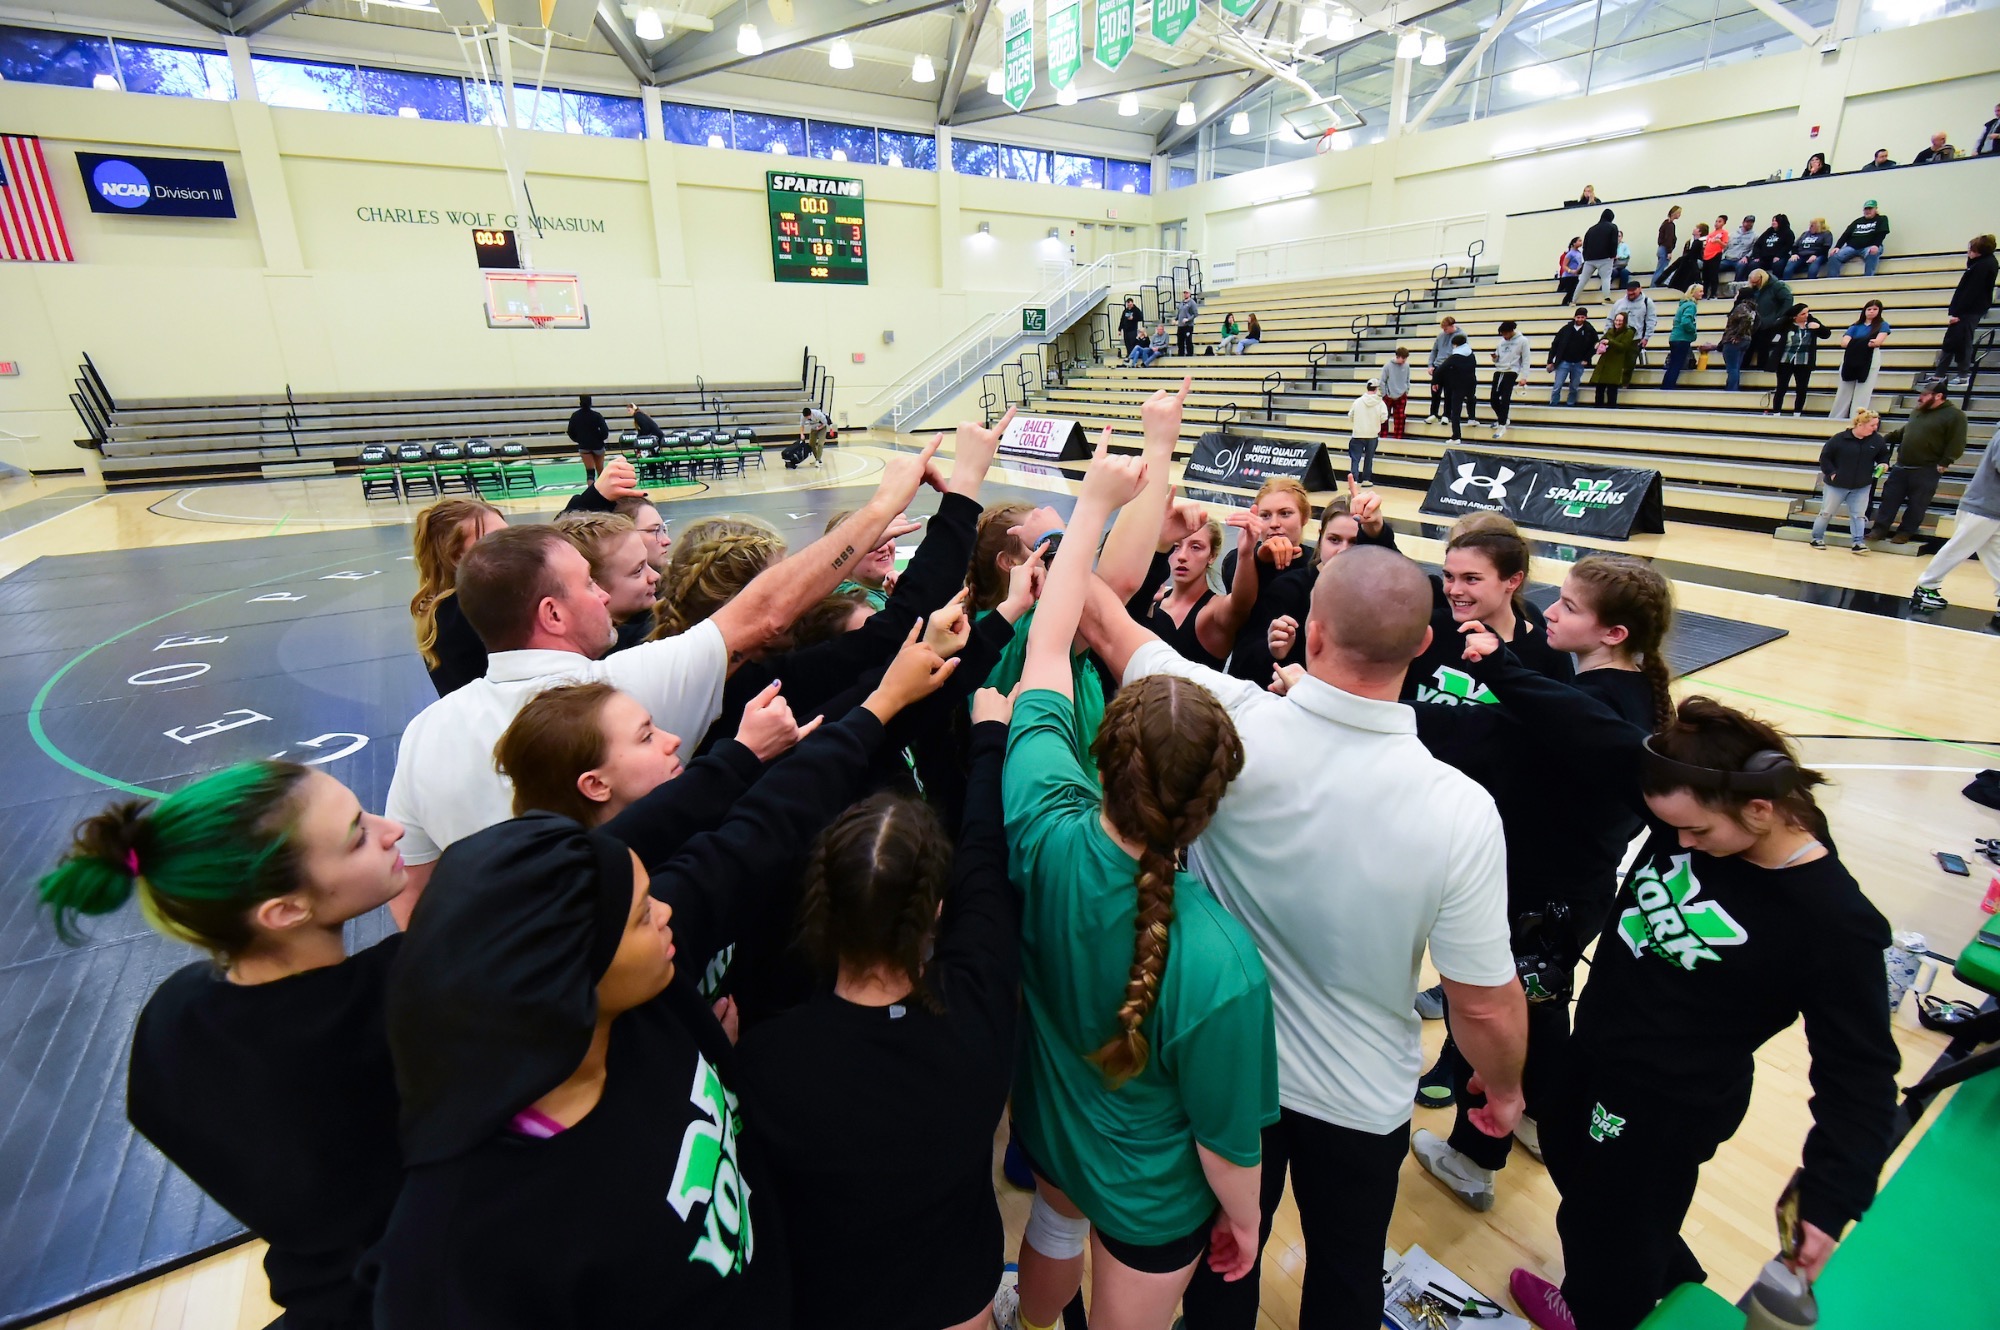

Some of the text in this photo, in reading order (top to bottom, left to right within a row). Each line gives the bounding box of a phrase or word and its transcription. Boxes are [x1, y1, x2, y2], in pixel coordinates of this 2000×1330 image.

[1100, 5, 1131, 47] 2019
[102, 183, 224, 200] NCAA Division III
[773, 175, 860, 196] SPARTANS
[800, 197, 828, 214] 00.0
[357, 207, 605, 233] CHARLES WOLF GMNASIUM
[781, 221, 799, 236] 44
[819, 225, 824, 236] 1
[852, 226, 860, 240] 3
[475, 232, 506, 245] 00.0
[782, 242, 790, 253] 4
[853, 246, 861, 256] 4
[1023, 420, 1054, 434] BAILEY
[1019, 433, 1049, 448] COACH
[1252, 444, 1307, 458] HIGH QUALITY
[1244, 453, 1309, 467] SPORTS MEDICINE
[1190, 462, 1225, 476] OSS Health
[1544, 486, 1628, 505] SPARTANS
[1440, 496, 1504, 511] UNDER ARMOUR
[1634, 853, 1722, 971] YORK
